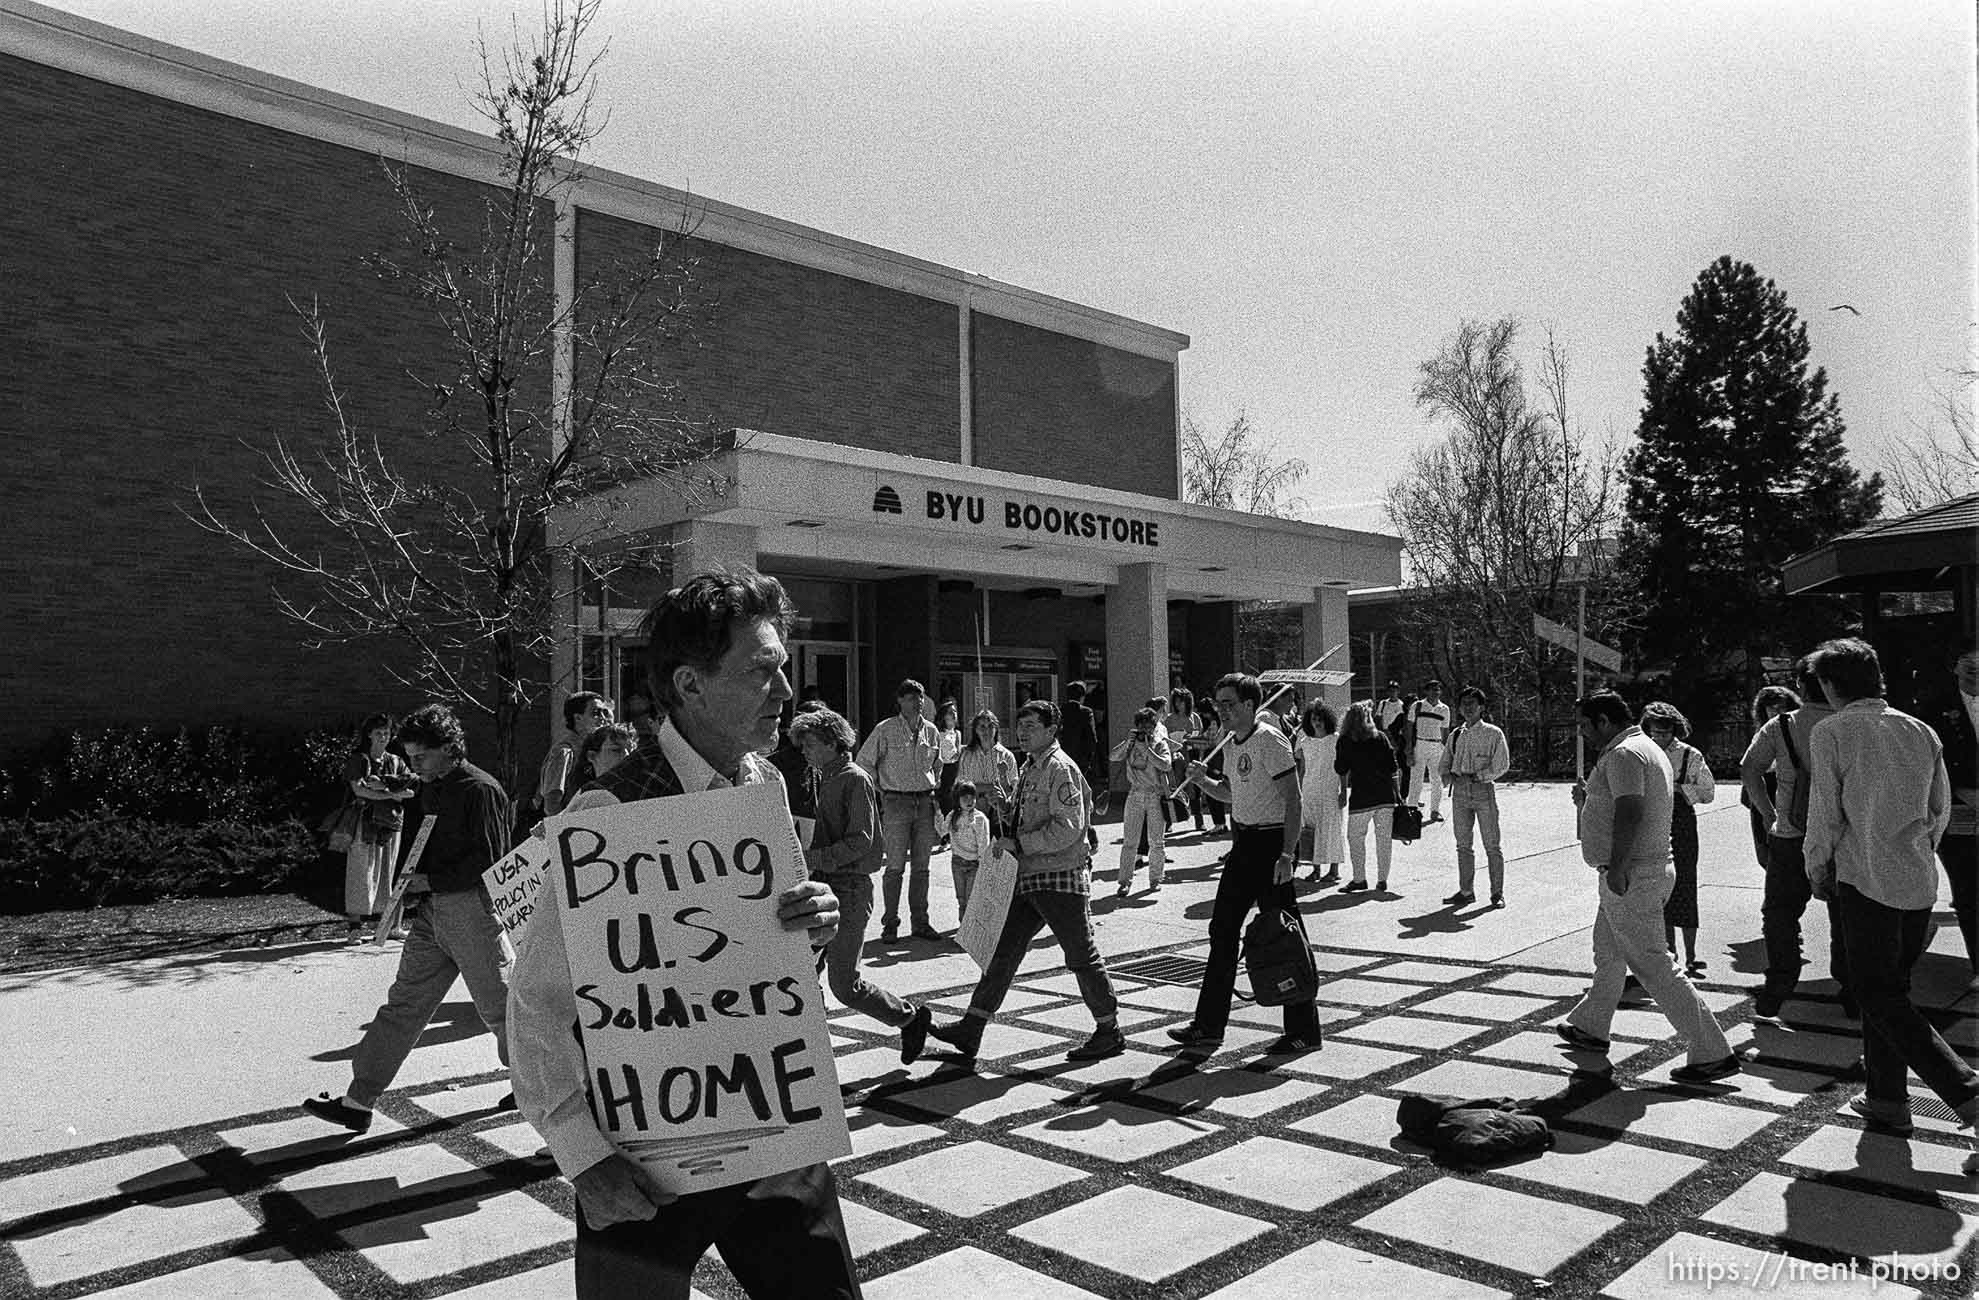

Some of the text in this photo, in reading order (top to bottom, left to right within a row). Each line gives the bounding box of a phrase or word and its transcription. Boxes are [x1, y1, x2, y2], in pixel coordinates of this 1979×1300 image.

[926, 490, 1159, 547] BYU BOOKSTORE
[493, 852, 530, 885] USA
[494, 873, 542, 917] POLICY IN
[557, 826, 774, 909] Bring
[575, 976, 804, 1032] Soldiers
[596, 1037, 823, 1132] HOME
